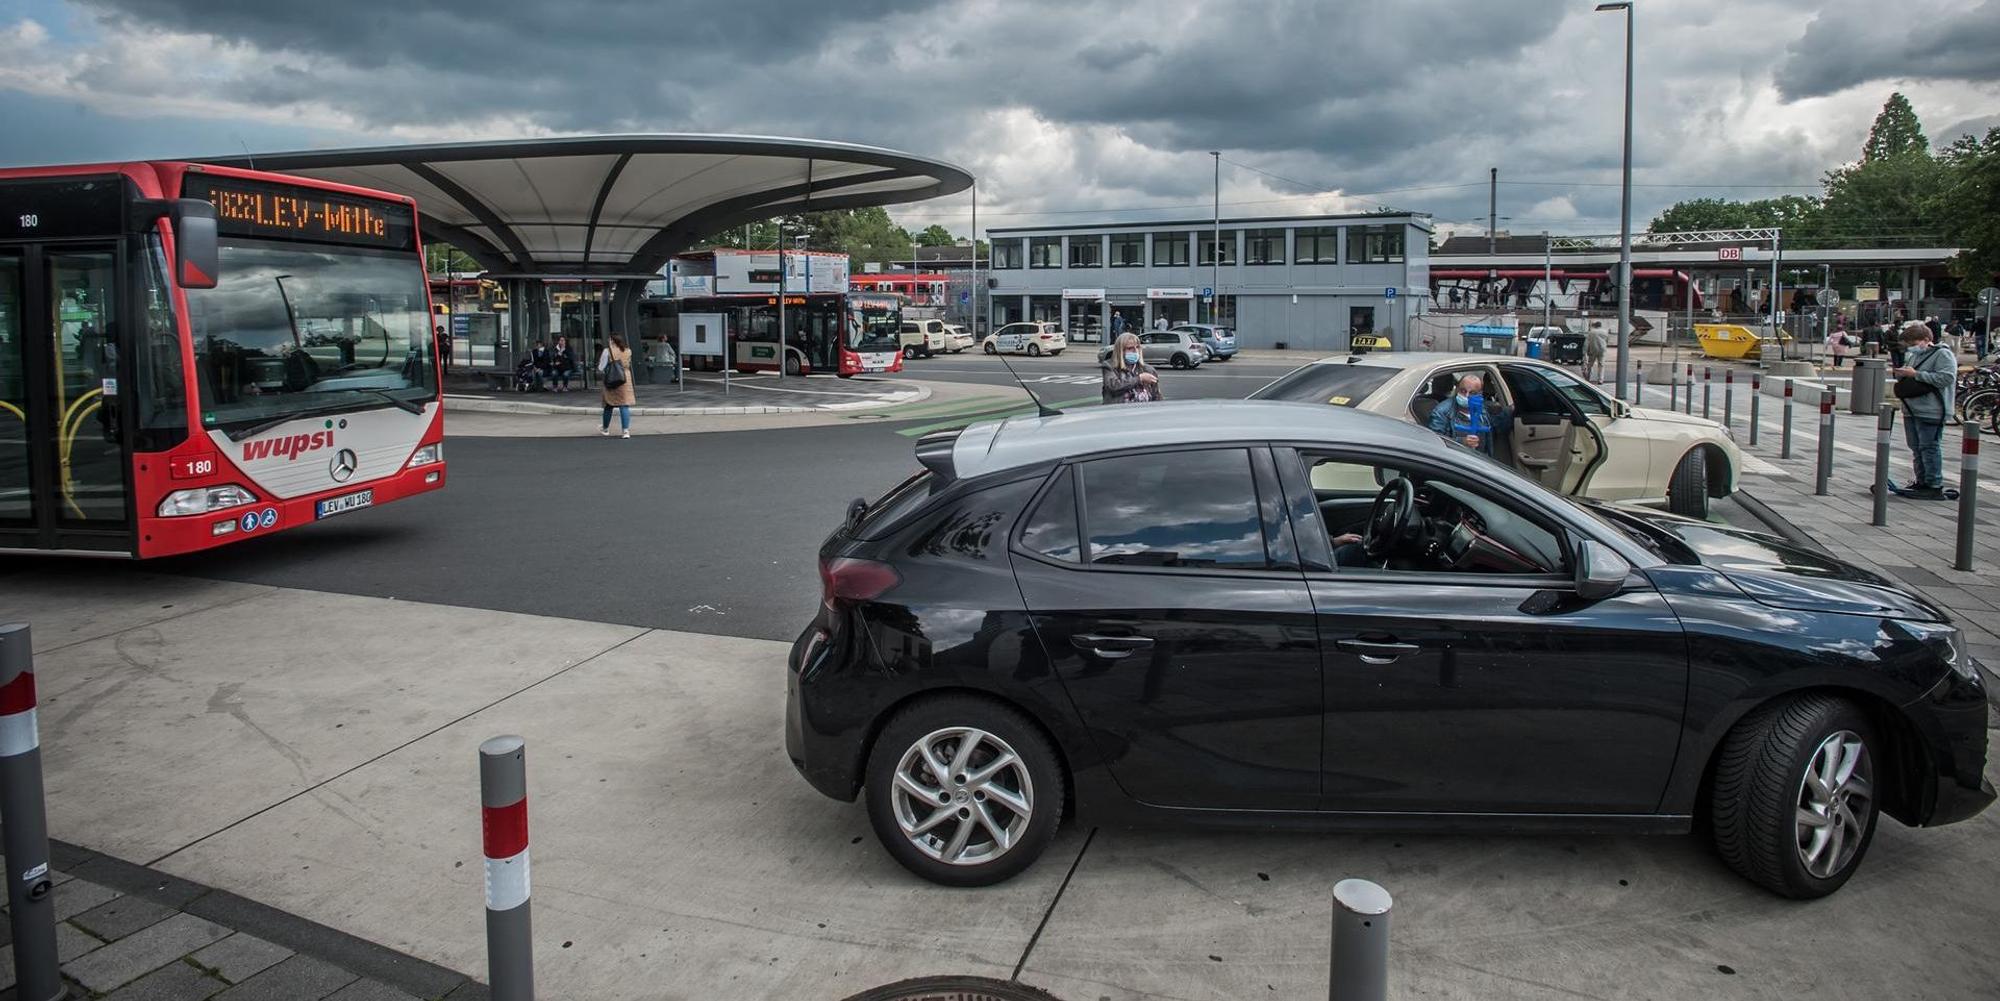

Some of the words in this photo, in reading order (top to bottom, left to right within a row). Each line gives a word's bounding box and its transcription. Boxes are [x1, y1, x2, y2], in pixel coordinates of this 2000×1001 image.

[20, 214, 38, 228] 180
[1721, 249, 1738, 259] DB
[1357, 337, 1376, 346] TAXI
[243, 419, 334, 461] wupsi
[186, 460, 212, 475] 180
[323, 499, 339, 514] LEV
[356, 491, 372, 506] 180
